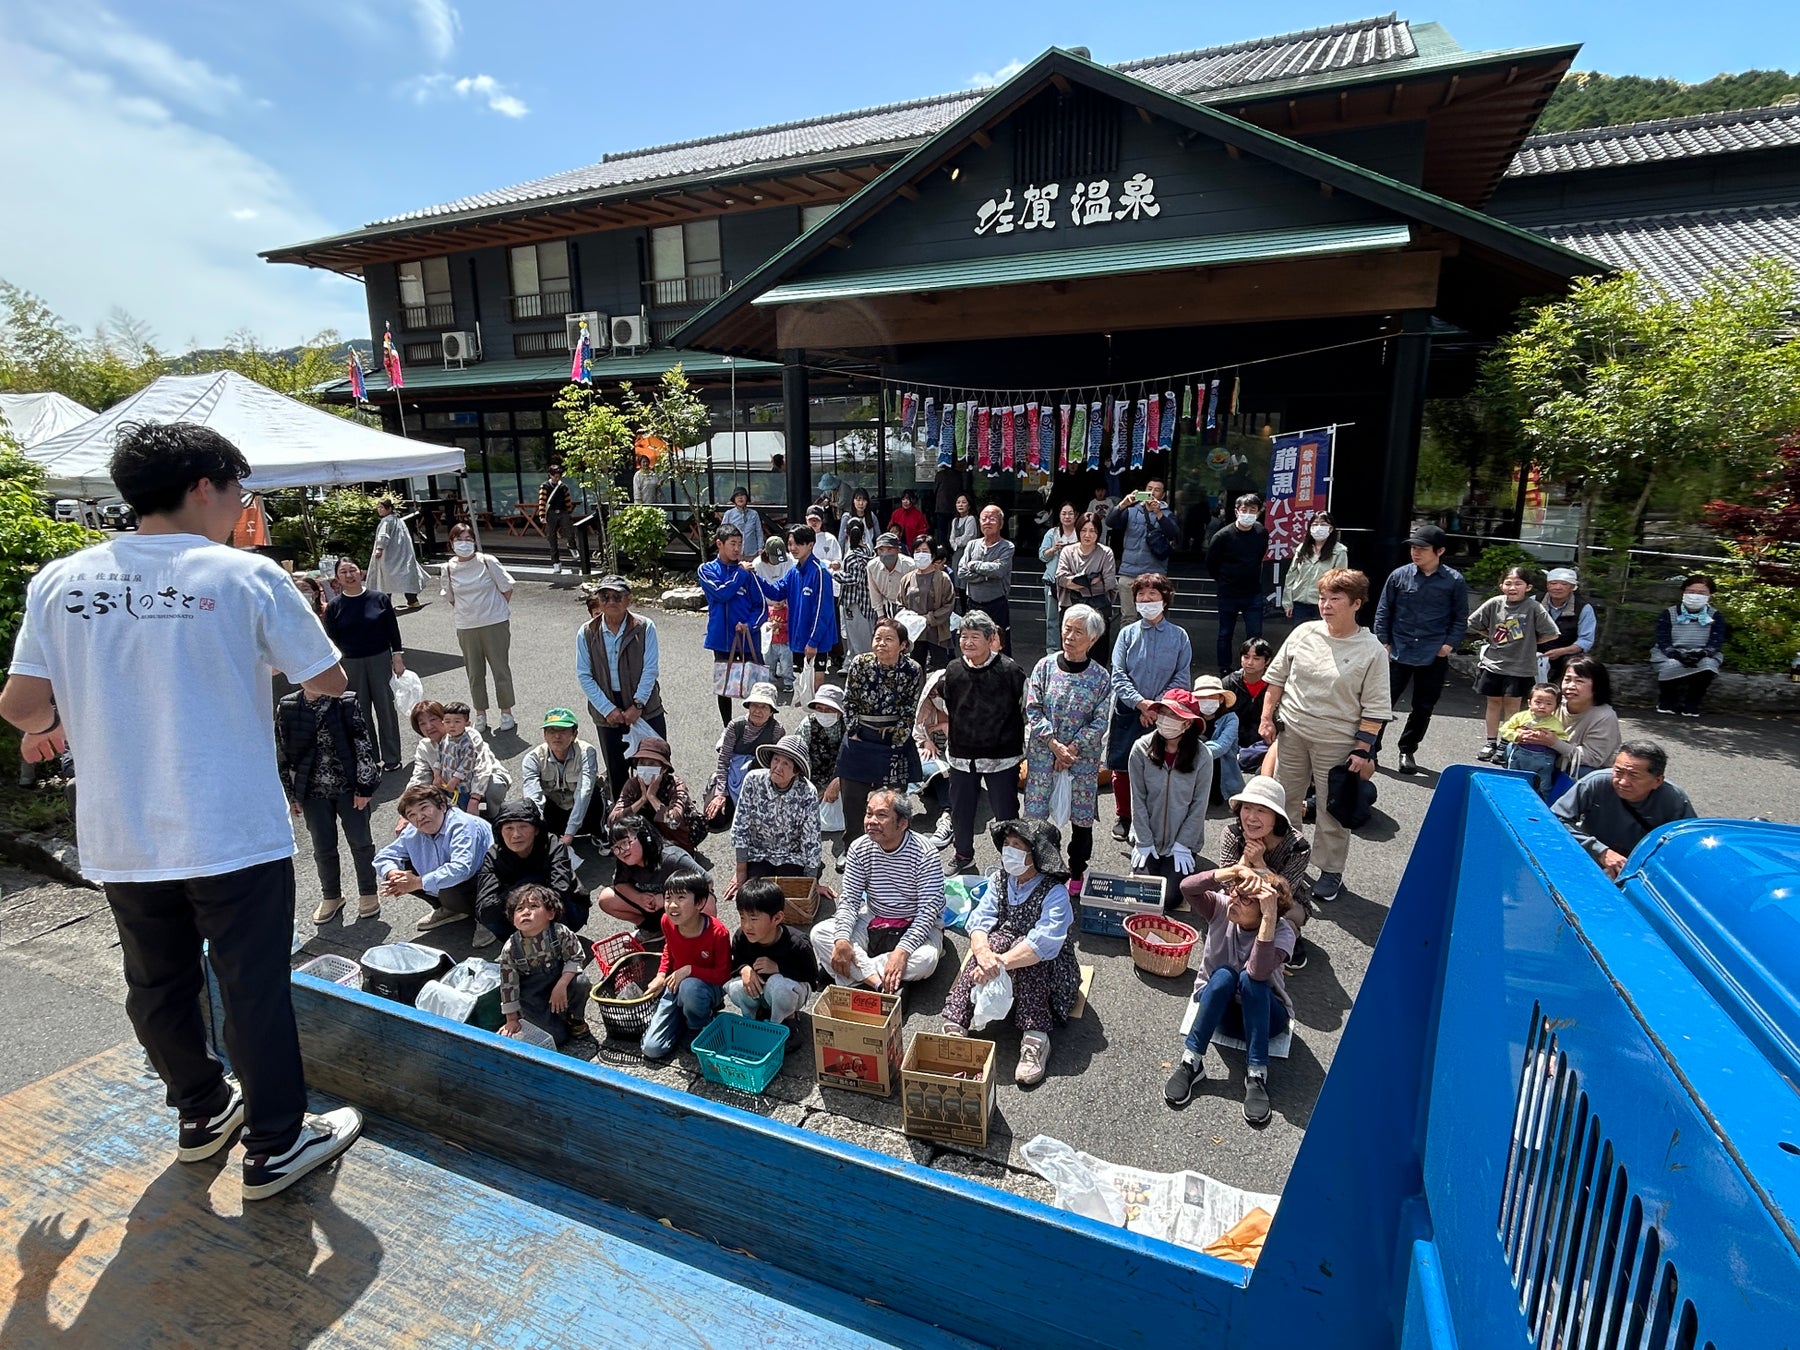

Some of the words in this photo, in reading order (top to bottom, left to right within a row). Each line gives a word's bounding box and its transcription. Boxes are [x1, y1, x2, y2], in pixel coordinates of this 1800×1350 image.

[974, 173, 1160, 235] 佐賀温泉
[95, 572, 142, 583] 佐賀温泉
[65, 586, 196, 620] こぶしのさと
